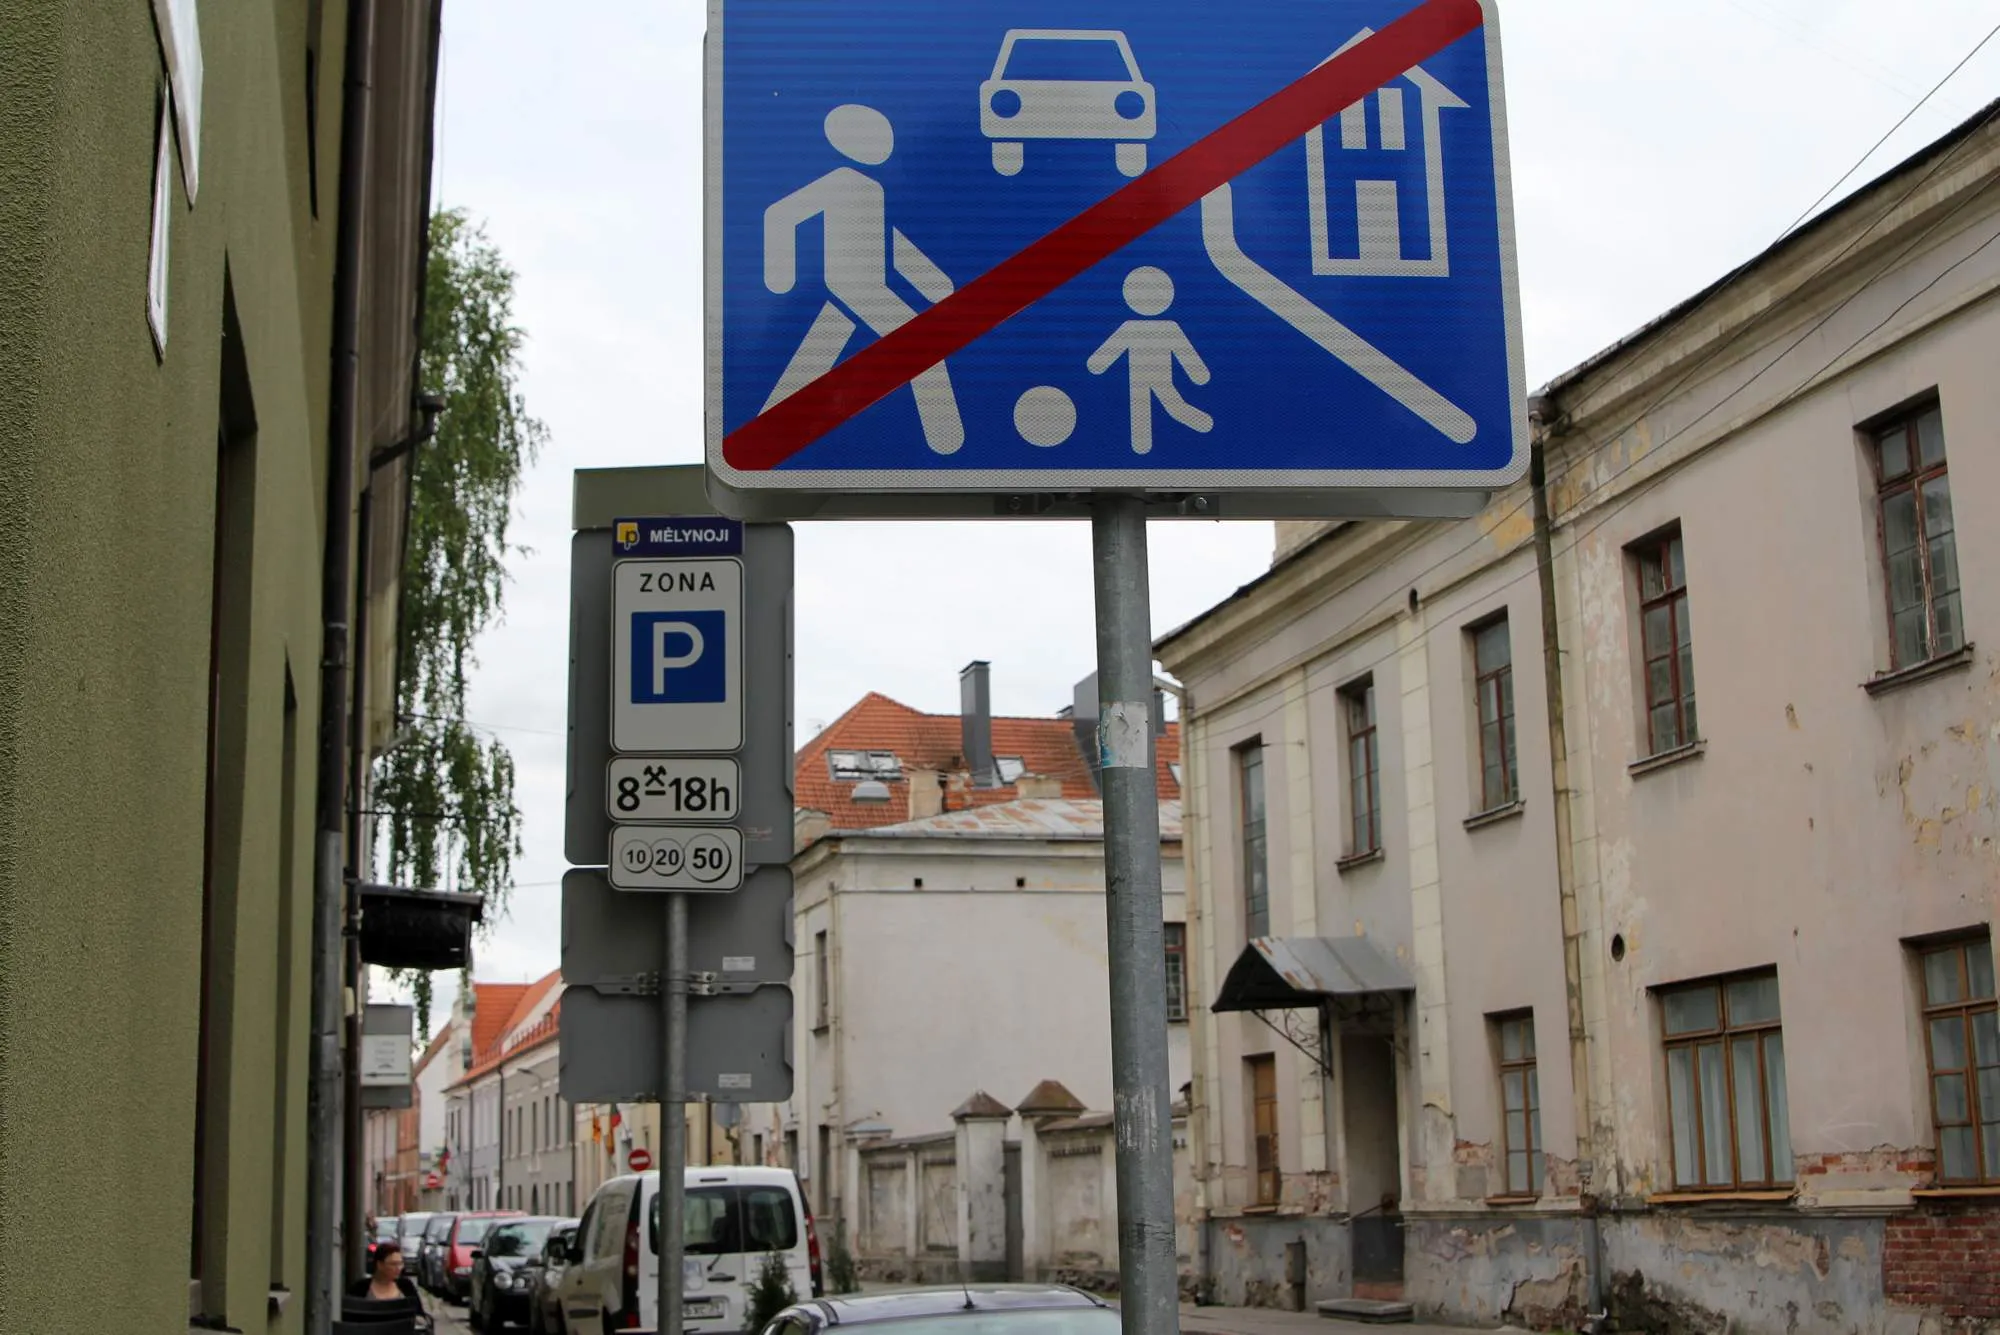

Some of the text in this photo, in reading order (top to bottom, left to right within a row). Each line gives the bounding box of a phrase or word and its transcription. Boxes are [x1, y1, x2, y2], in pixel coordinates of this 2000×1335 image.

[650, 527, 729, 543] MĖLYNOJI
[640, 572, 716, 593] ZONA
[653, 621, 705, 695] P
[626, 848, 723, 869] 10 20 50
